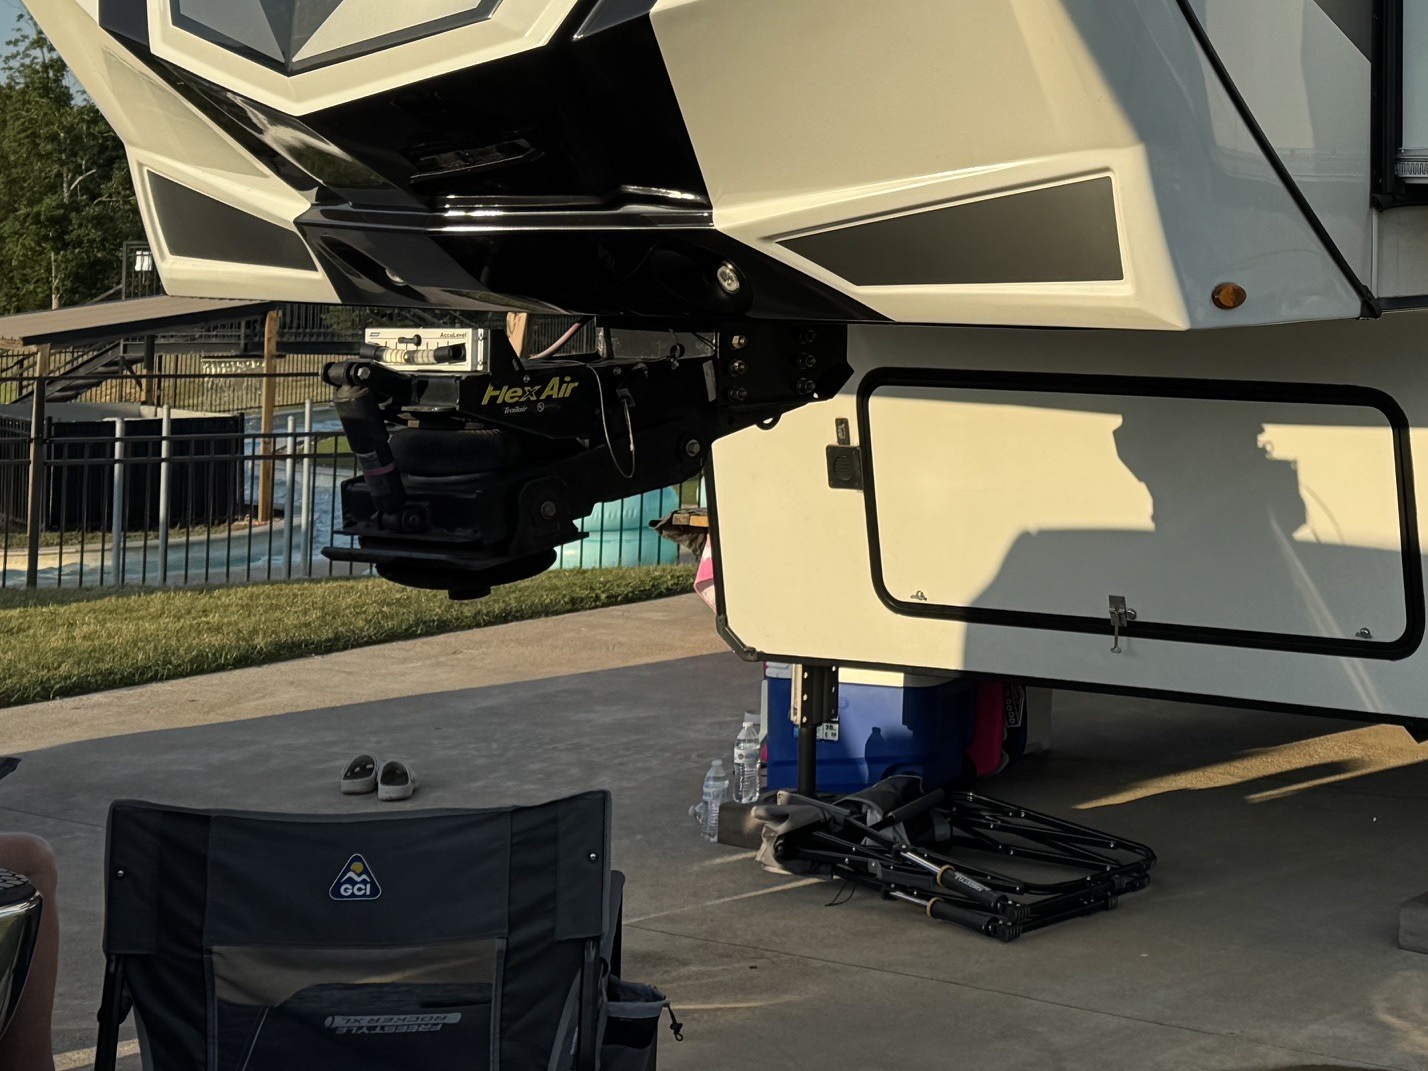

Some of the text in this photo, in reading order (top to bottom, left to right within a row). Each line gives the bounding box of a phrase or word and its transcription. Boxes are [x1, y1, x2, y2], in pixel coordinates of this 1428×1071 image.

[340, 883, 371, 897] GCI
[342, 1015, 448, 1026] ROCKER XL
[335, 1023, 443, 1035] FREESTYLE
